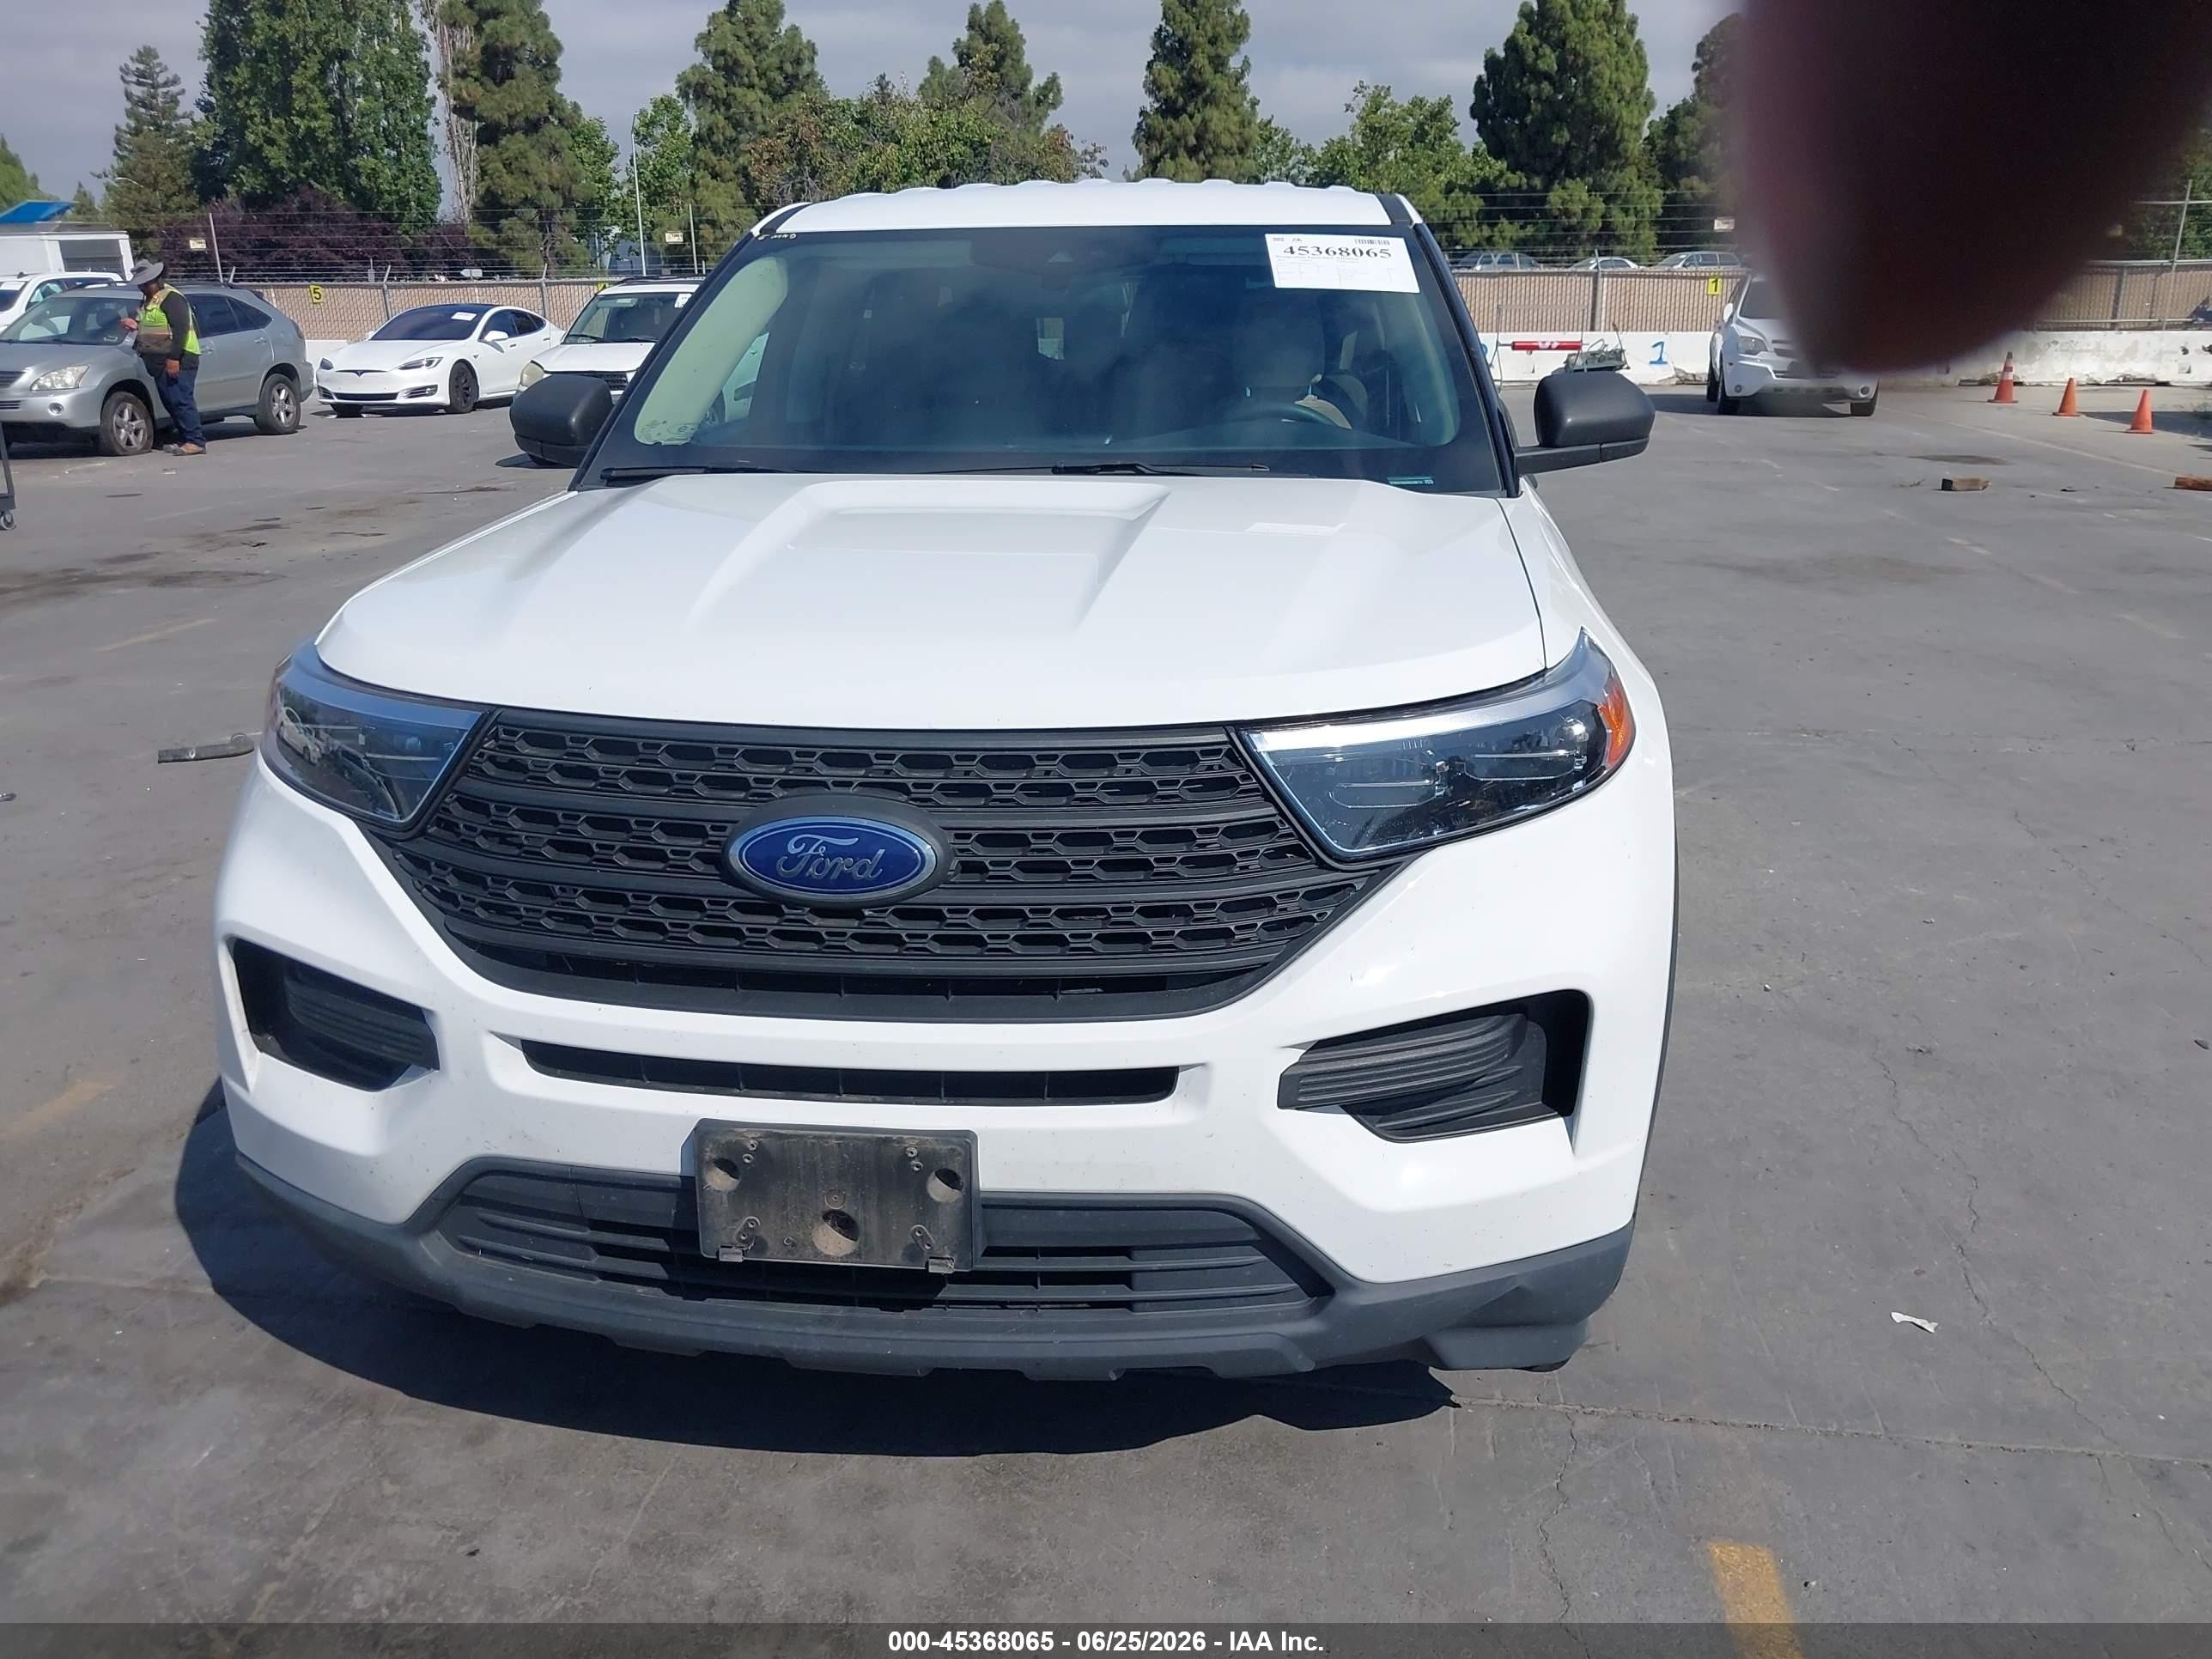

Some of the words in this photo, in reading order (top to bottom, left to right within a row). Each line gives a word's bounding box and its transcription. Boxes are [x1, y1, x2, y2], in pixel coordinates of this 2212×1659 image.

[1283, 246, 1392, 258] 45368065
[313, 288, 322, 301] 5
[1649, 341, 1668, 365] 1
[776, 834, 886, 881] Ford
